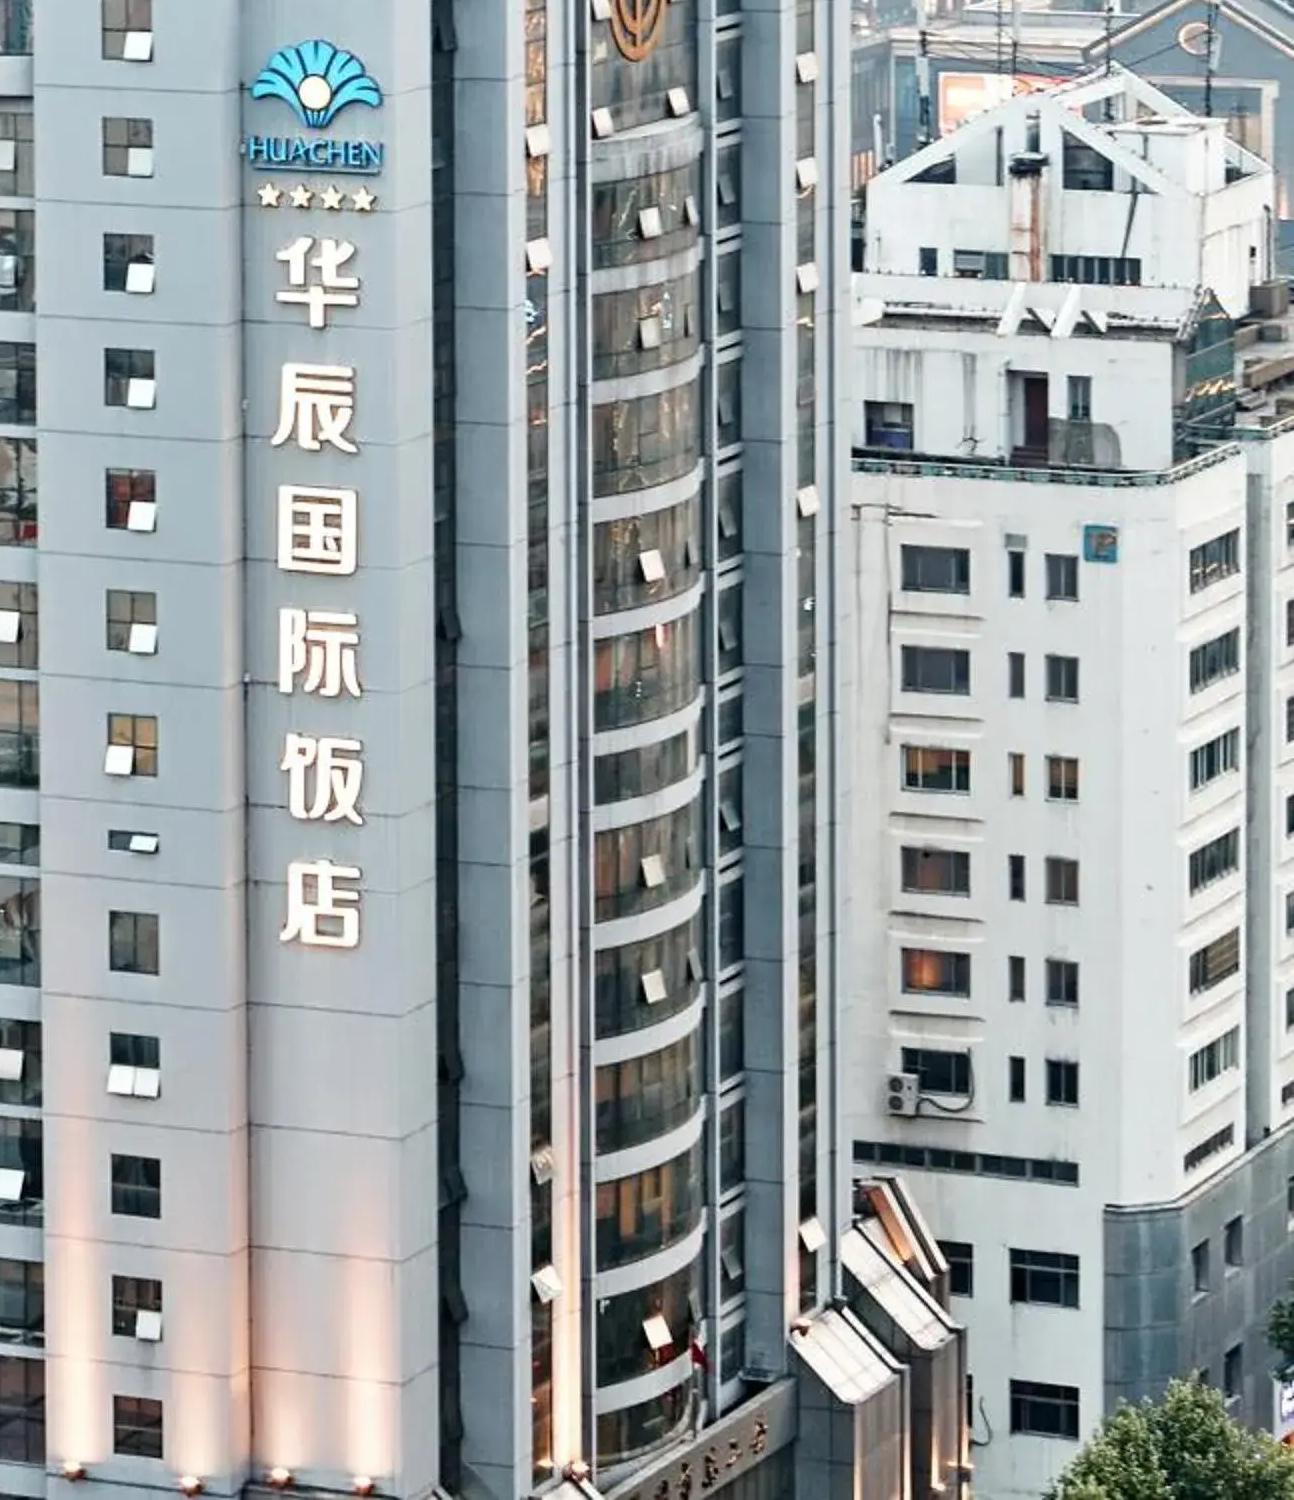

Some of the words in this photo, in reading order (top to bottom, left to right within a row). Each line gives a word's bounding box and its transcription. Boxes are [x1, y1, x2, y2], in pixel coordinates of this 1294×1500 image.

[249, 136, 384, 166] HUACHEN
[271, 237, 363, 948] 华辰国际饭店
